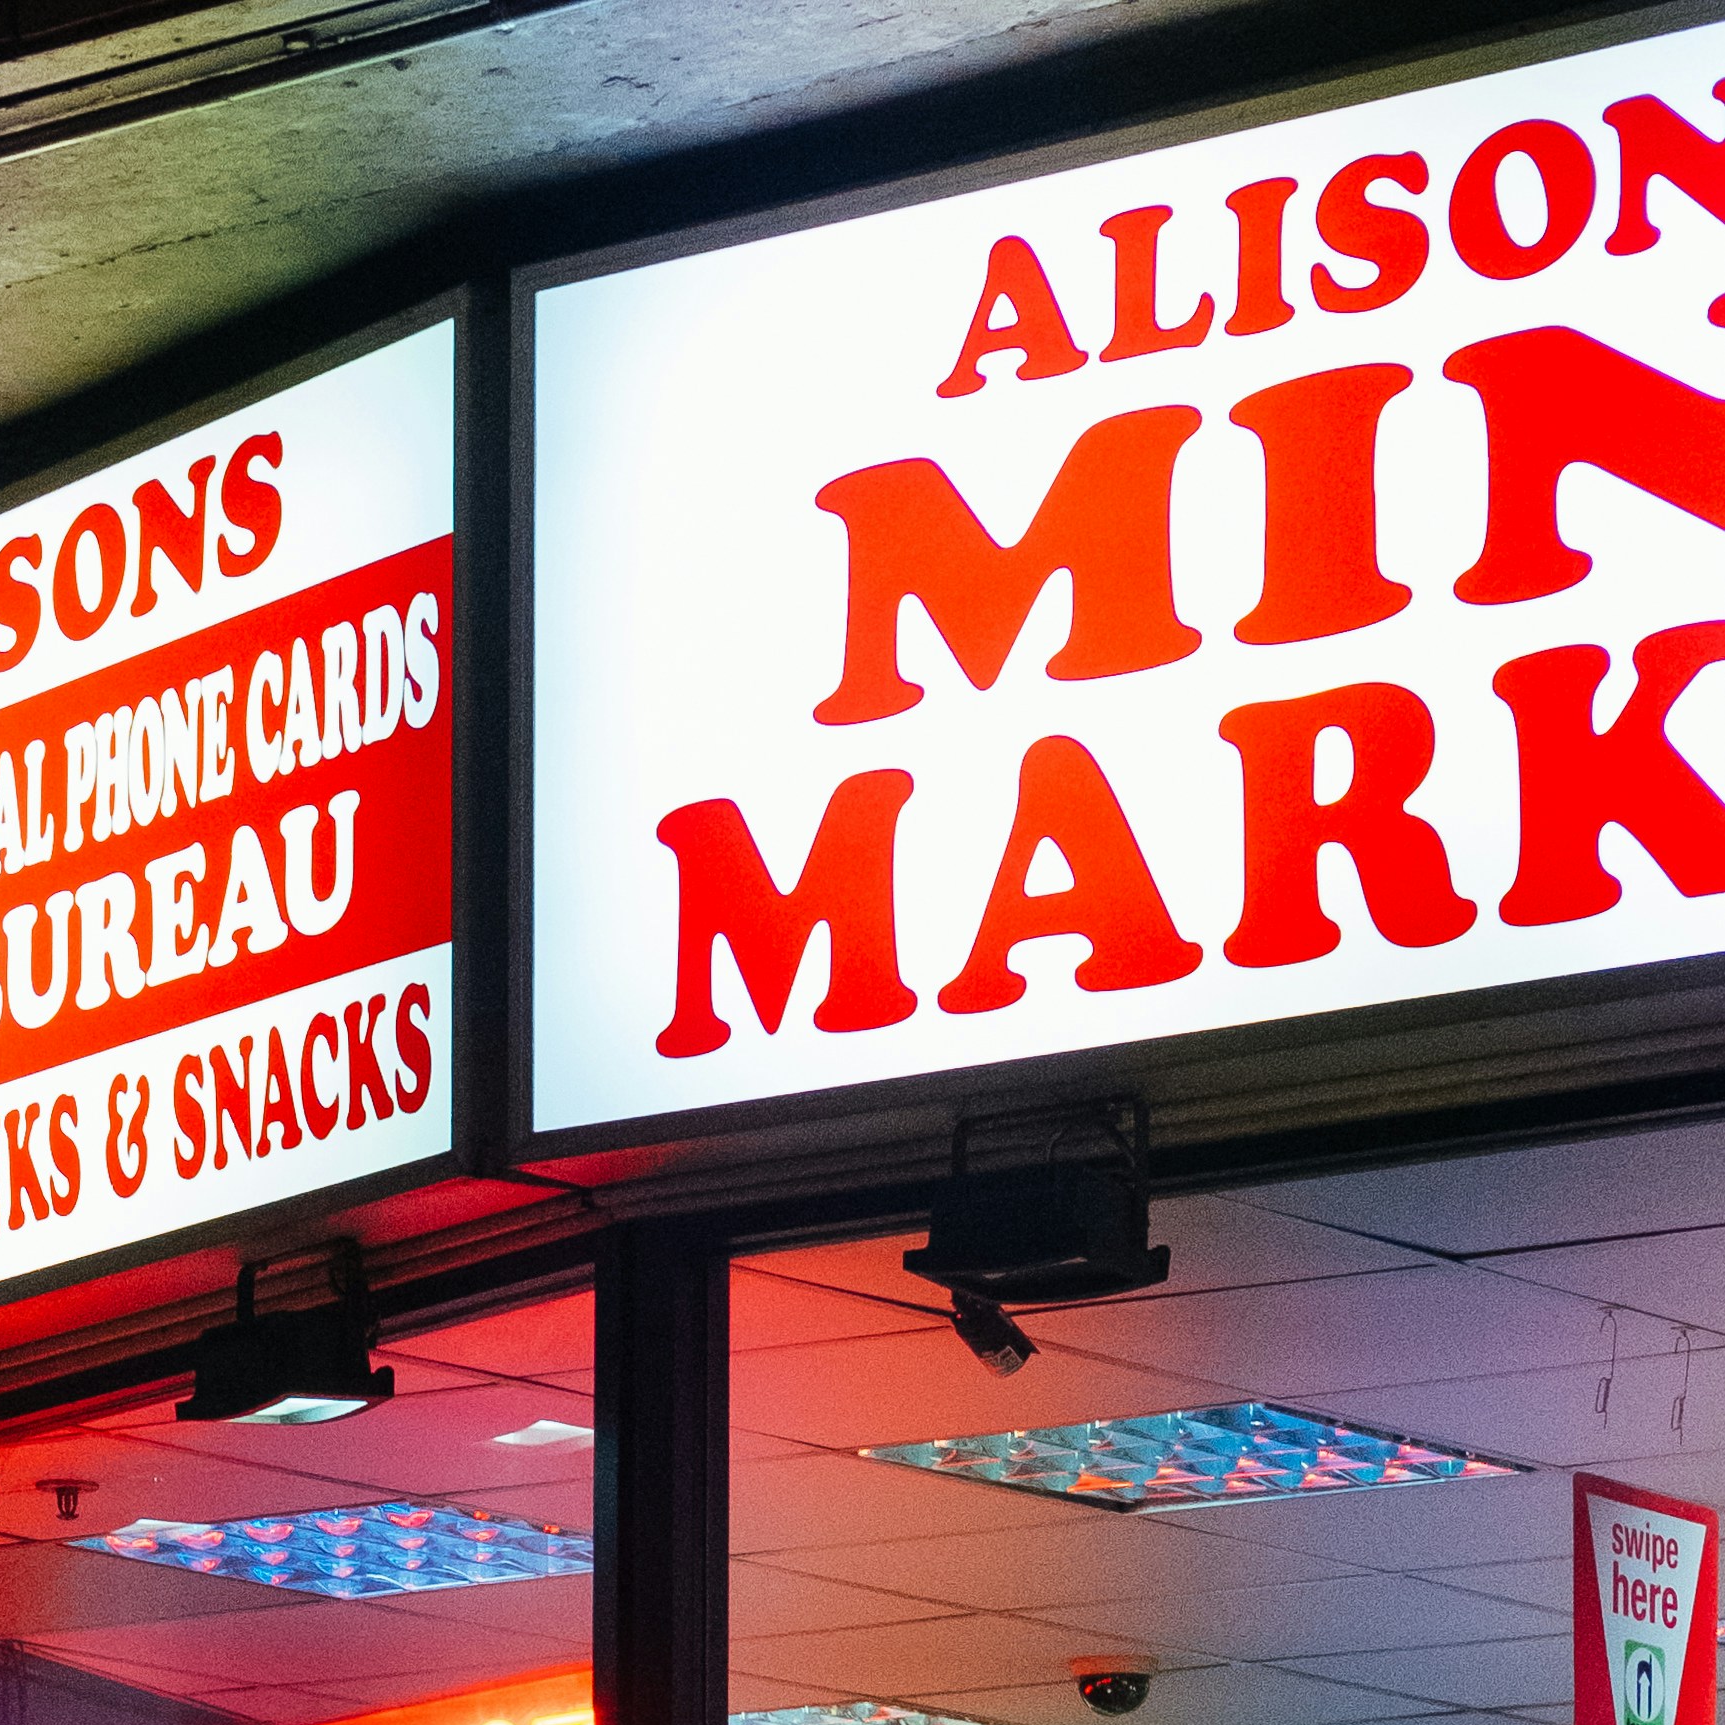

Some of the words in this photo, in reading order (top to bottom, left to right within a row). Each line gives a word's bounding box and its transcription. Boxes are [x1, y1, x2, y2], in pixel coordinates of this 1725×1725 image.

[62, 664, 234, 853] PHONE
[245, 590, 439, 785] CARDS
[656, 619, 1725, 1059] MARK
[105, 1071, 148, 1199] &
[172, 981, 432, 1181] SNACKS
[1612, 1521, 1679, 1573] swipe
[1612, 1561, 1678, 1629] here
